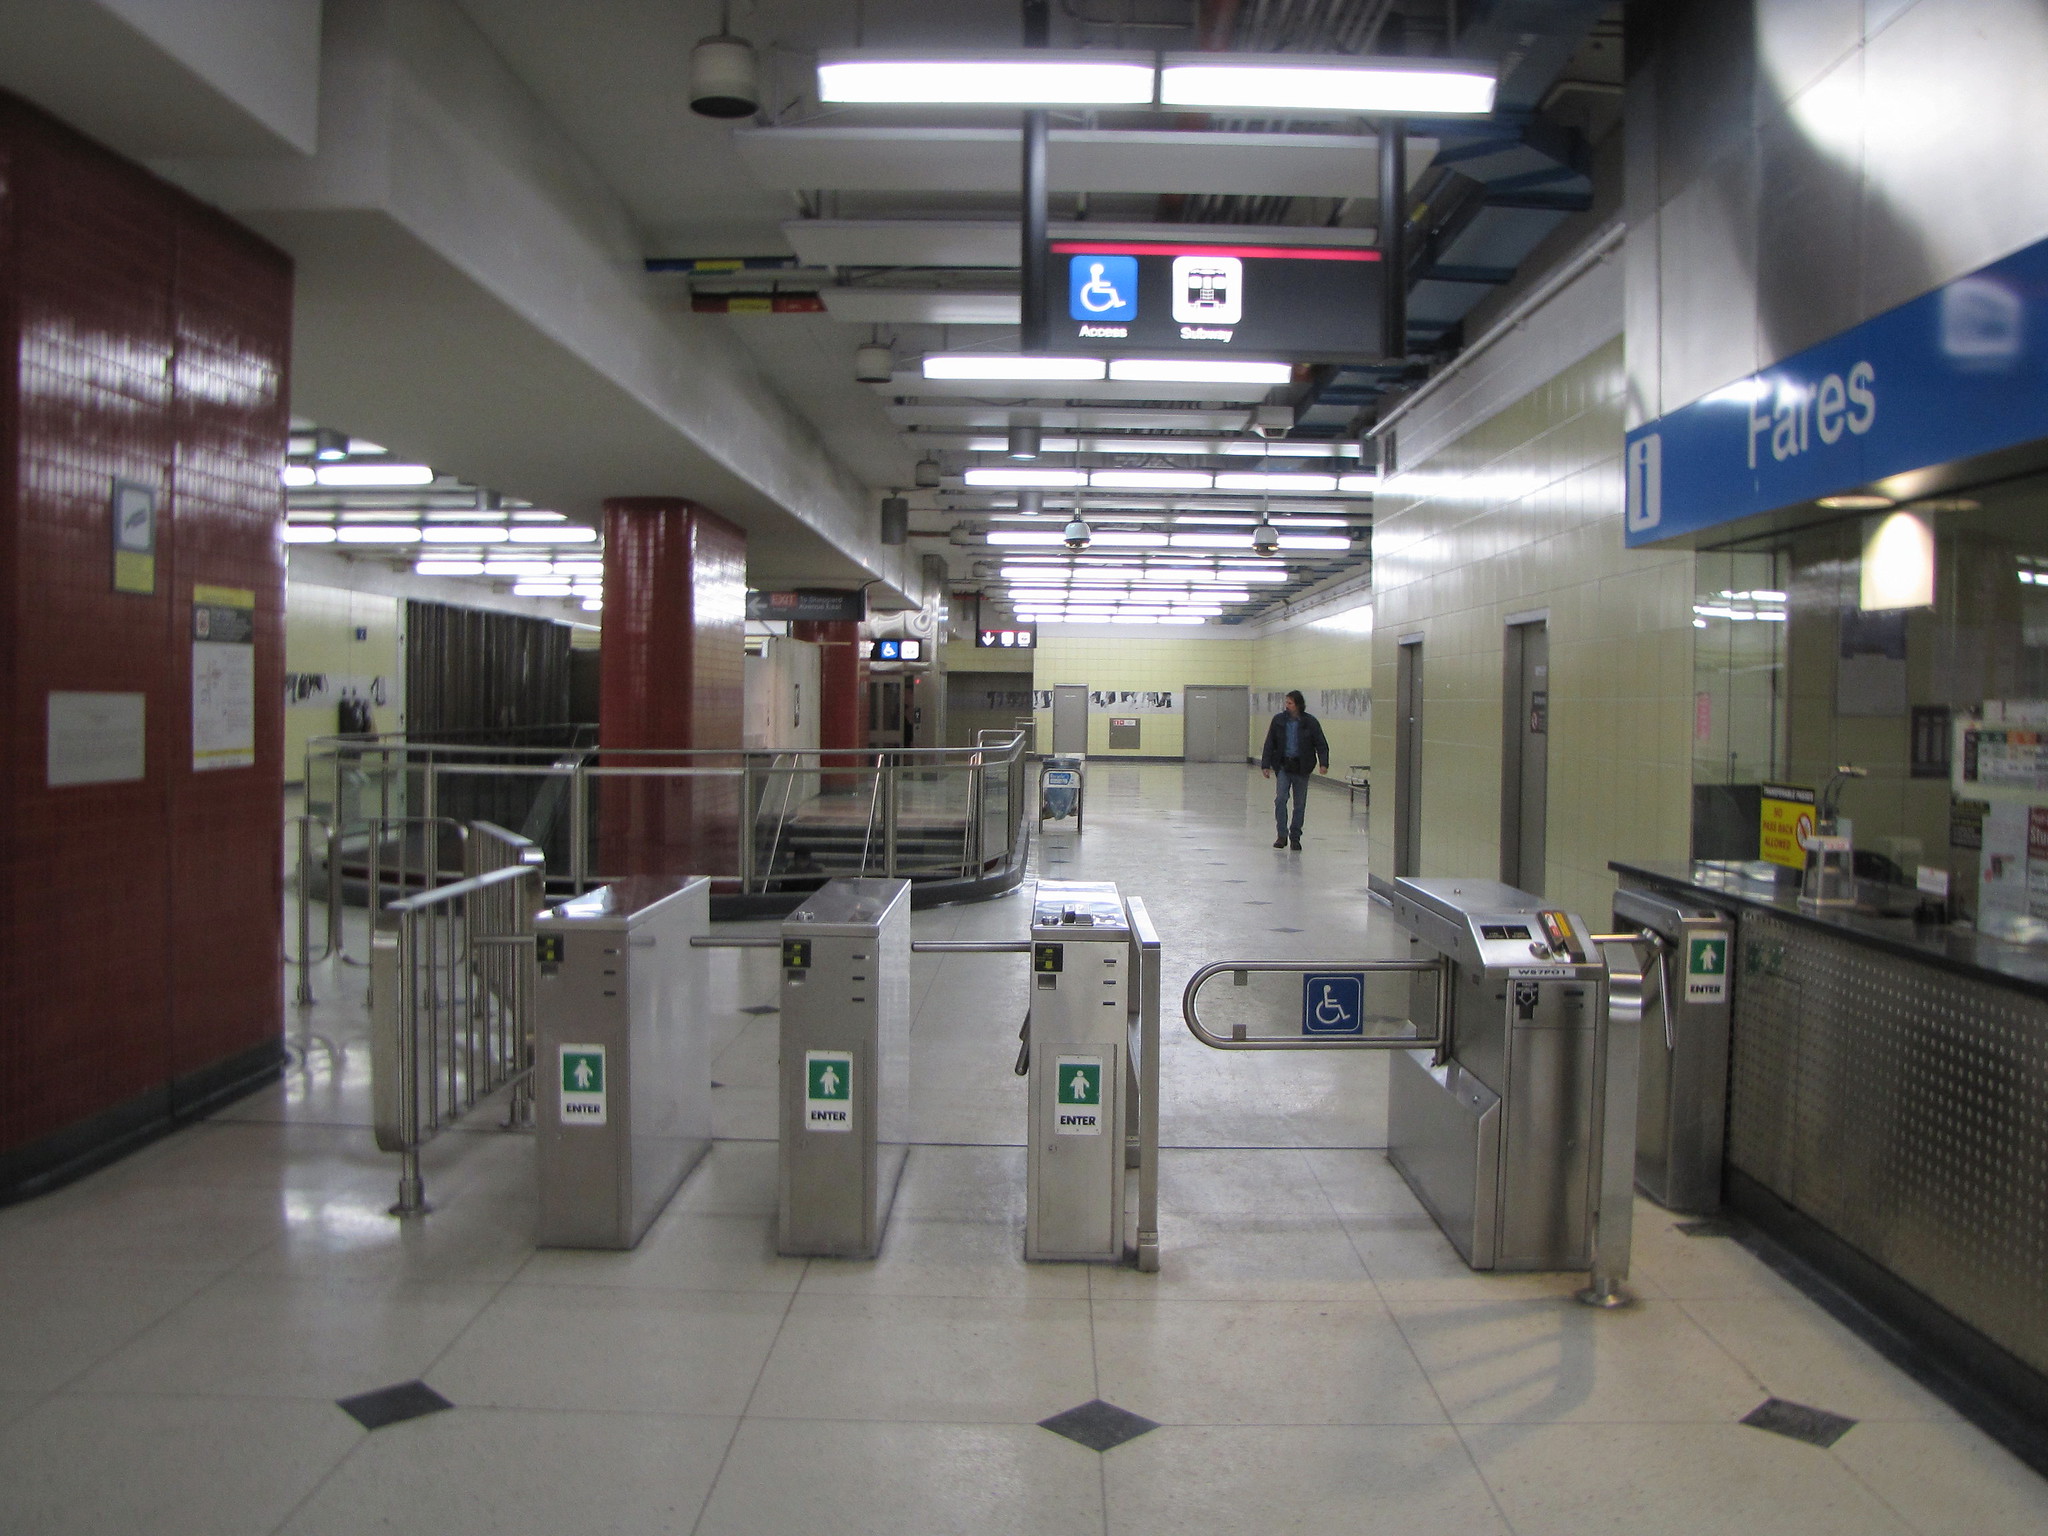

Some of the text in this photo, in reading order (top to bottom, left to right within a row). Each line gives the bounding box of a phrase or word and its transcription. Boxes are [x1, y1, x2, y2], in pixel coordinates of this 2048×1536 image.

[1079, 325, 1128, 338] Access
[1180, 326, 1233, 343] Subway
[1747, 361, 1876, 470] Fares
[772, 594, 796, 606] EXIT
[1690, 983, 1721, 993] ENTER
[566, 1103, 601, 1114] ENTER
[811, 1110, 846, 1121] ENTER
[1060, 1115, 1096, 1126] ENTER
